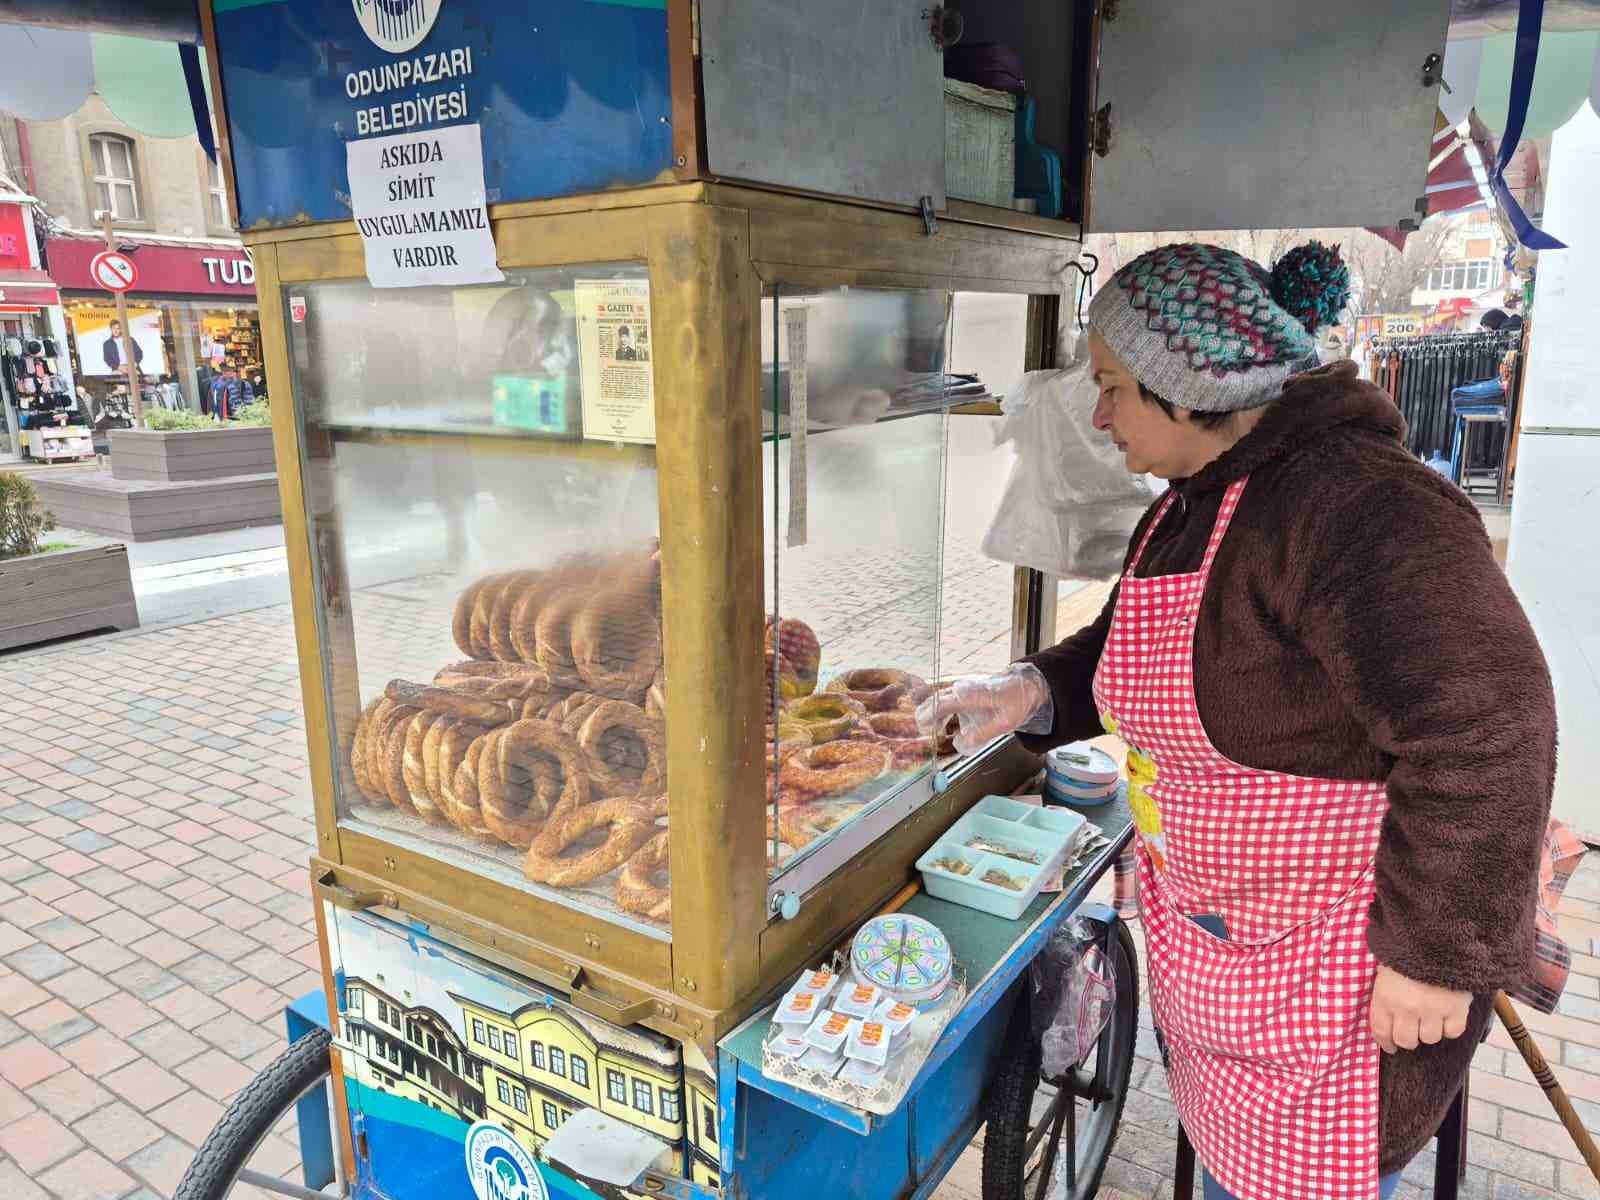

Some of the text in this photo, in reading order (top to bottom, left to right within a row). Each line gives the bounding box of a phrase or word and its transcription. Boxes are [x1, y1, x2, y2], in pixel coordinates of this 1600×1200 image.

[345, 46, 473, 98] ODUNPAZARI
[356, 84, 468, 135] BELEDİYESİ
[380, 140, 443, 169] ASKIDA
[388, 172, 435, 202] SİMİT
[357, 207, 486, 238] UYGULAMAMIZ
[393, 245, 459, 268] VARDIR
[1387, 324, 1414, 334] 200
